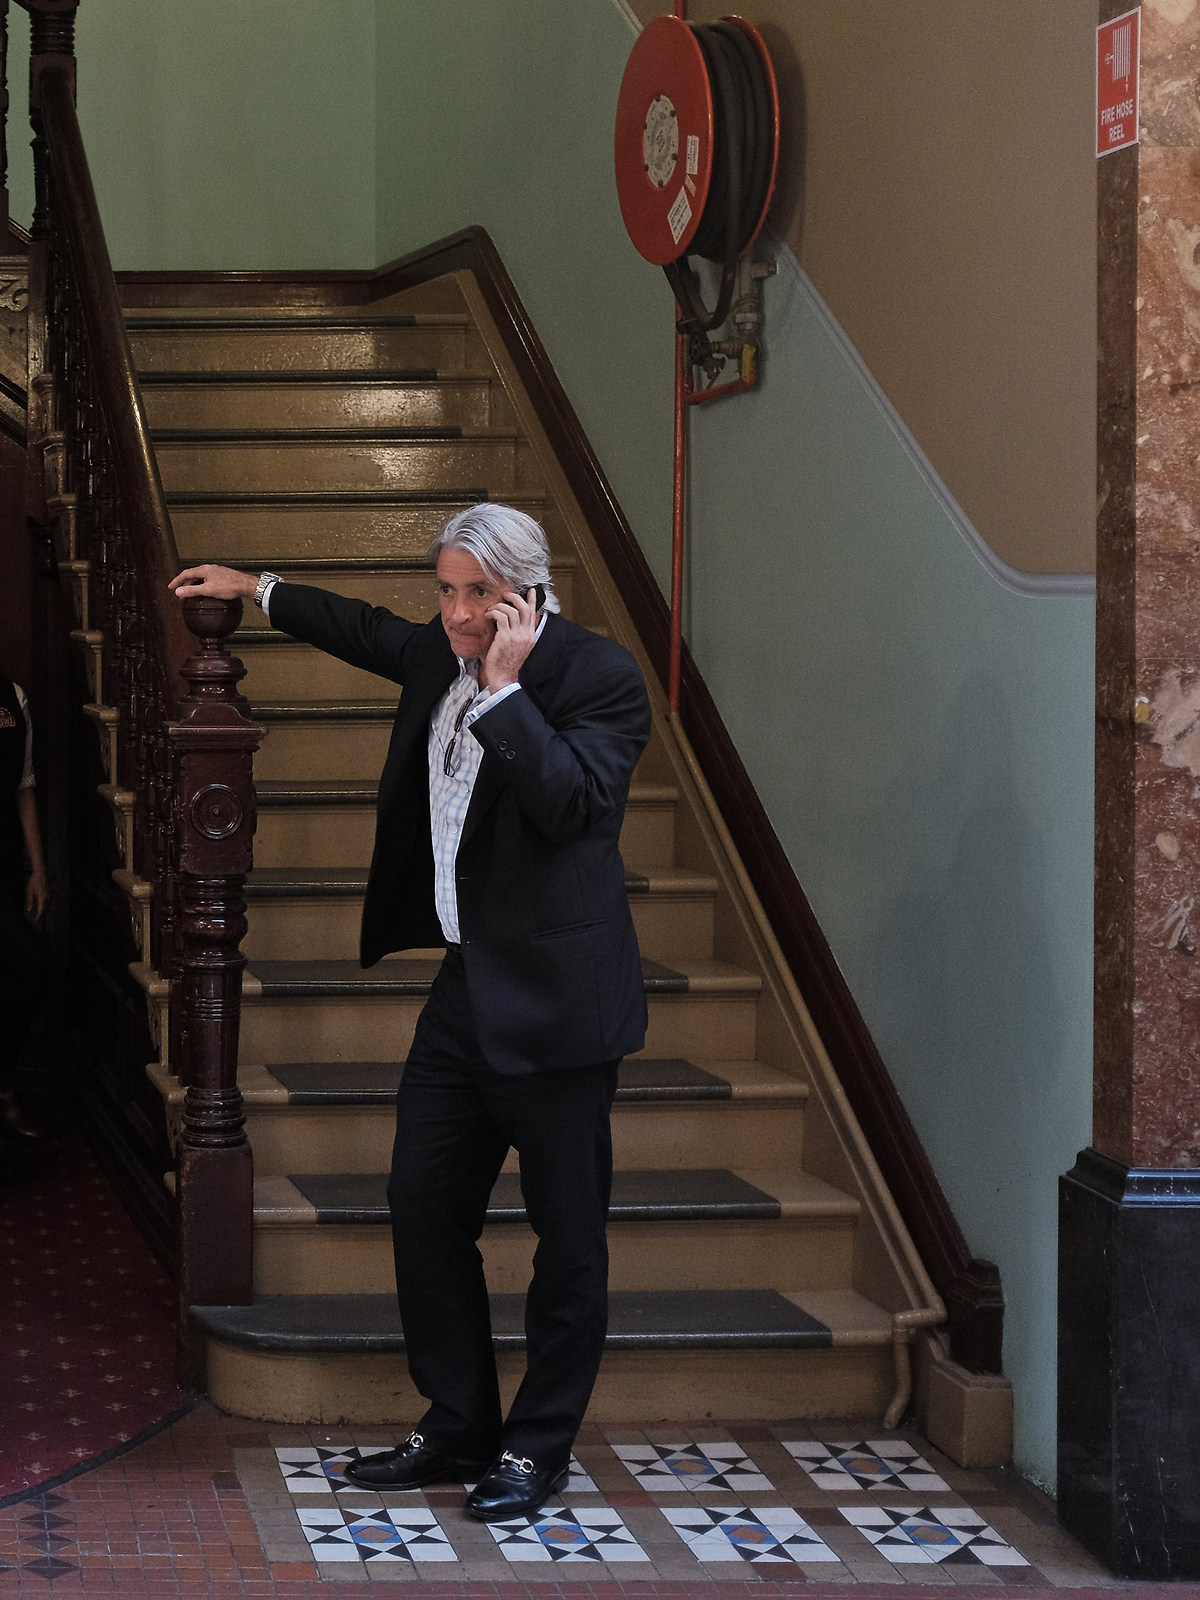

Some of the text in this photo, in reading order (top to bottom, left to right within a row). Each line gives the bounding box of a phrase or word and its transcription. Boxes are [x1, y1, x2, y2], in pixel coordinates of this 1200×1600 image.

[1101, 98, 1134, 125] FIRE HOSE
[1109, 124, 1125, 143] REEL
